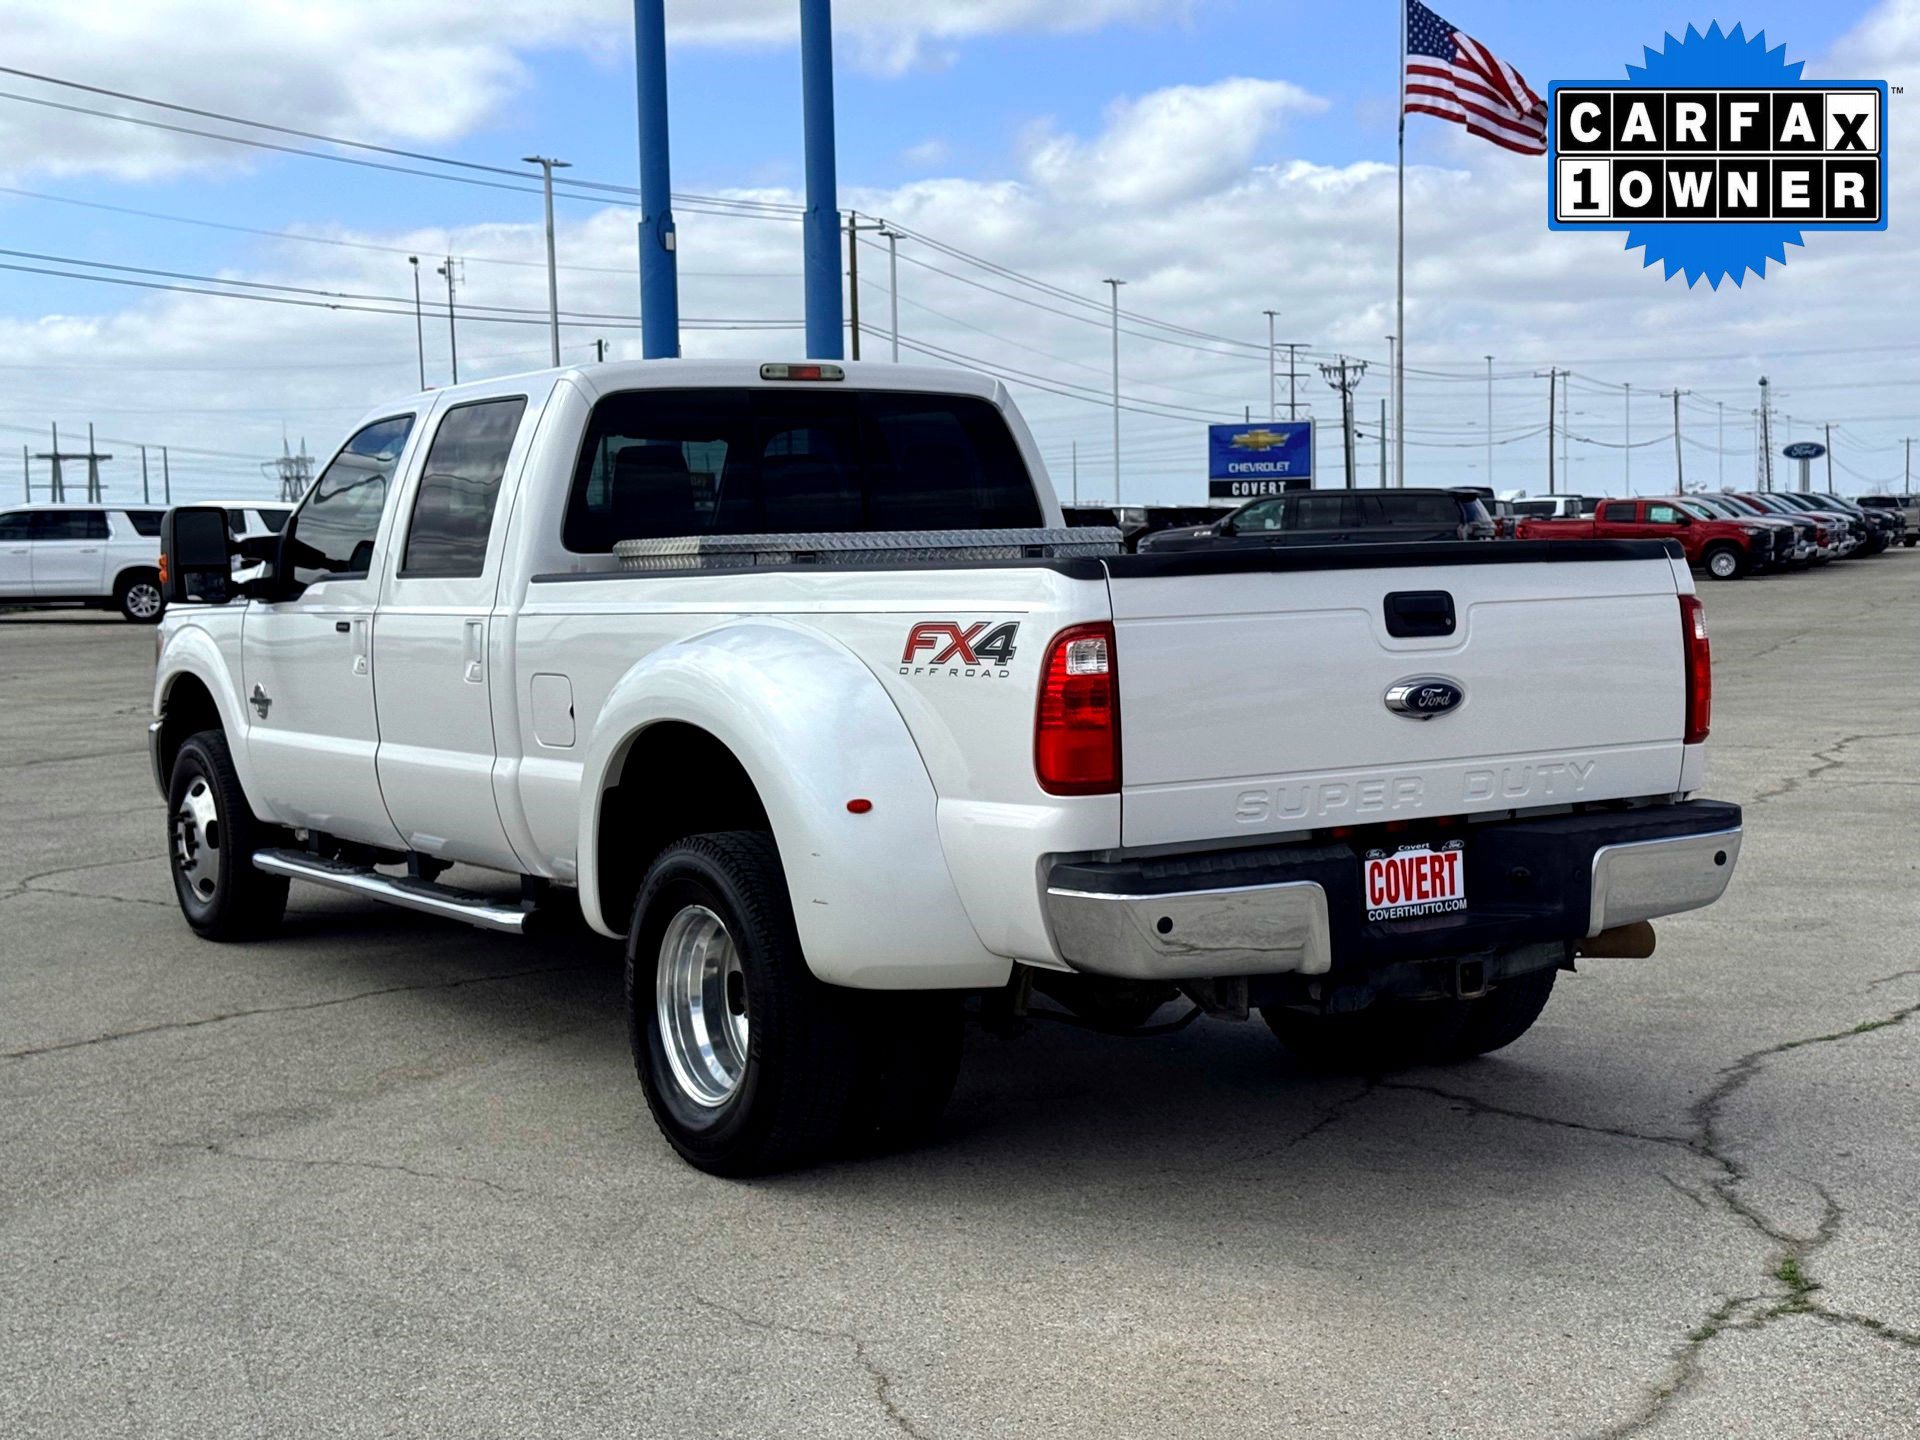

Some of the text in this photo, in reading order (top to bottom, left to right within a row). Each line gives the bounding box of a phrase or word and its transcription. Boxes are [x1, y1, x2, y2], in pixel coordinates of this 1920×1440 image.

[1228, 461, 1290, 473] CHEVROLET
[1231, 481, 1287, 496] COVERT
[901, 621, 1021, 666] FX4
[899, 667, 1010, 678] OFF ROAD
[1418, 687, 1452, 707] Ford
[1234, 760, 1596, 824] SUPER DUTY
[1398, 843, 1430, 851] Covert
[1369, 852, 1458, 907] COVERT
[1368, 898, 1467, 921] COVERTHUTTO.COM
